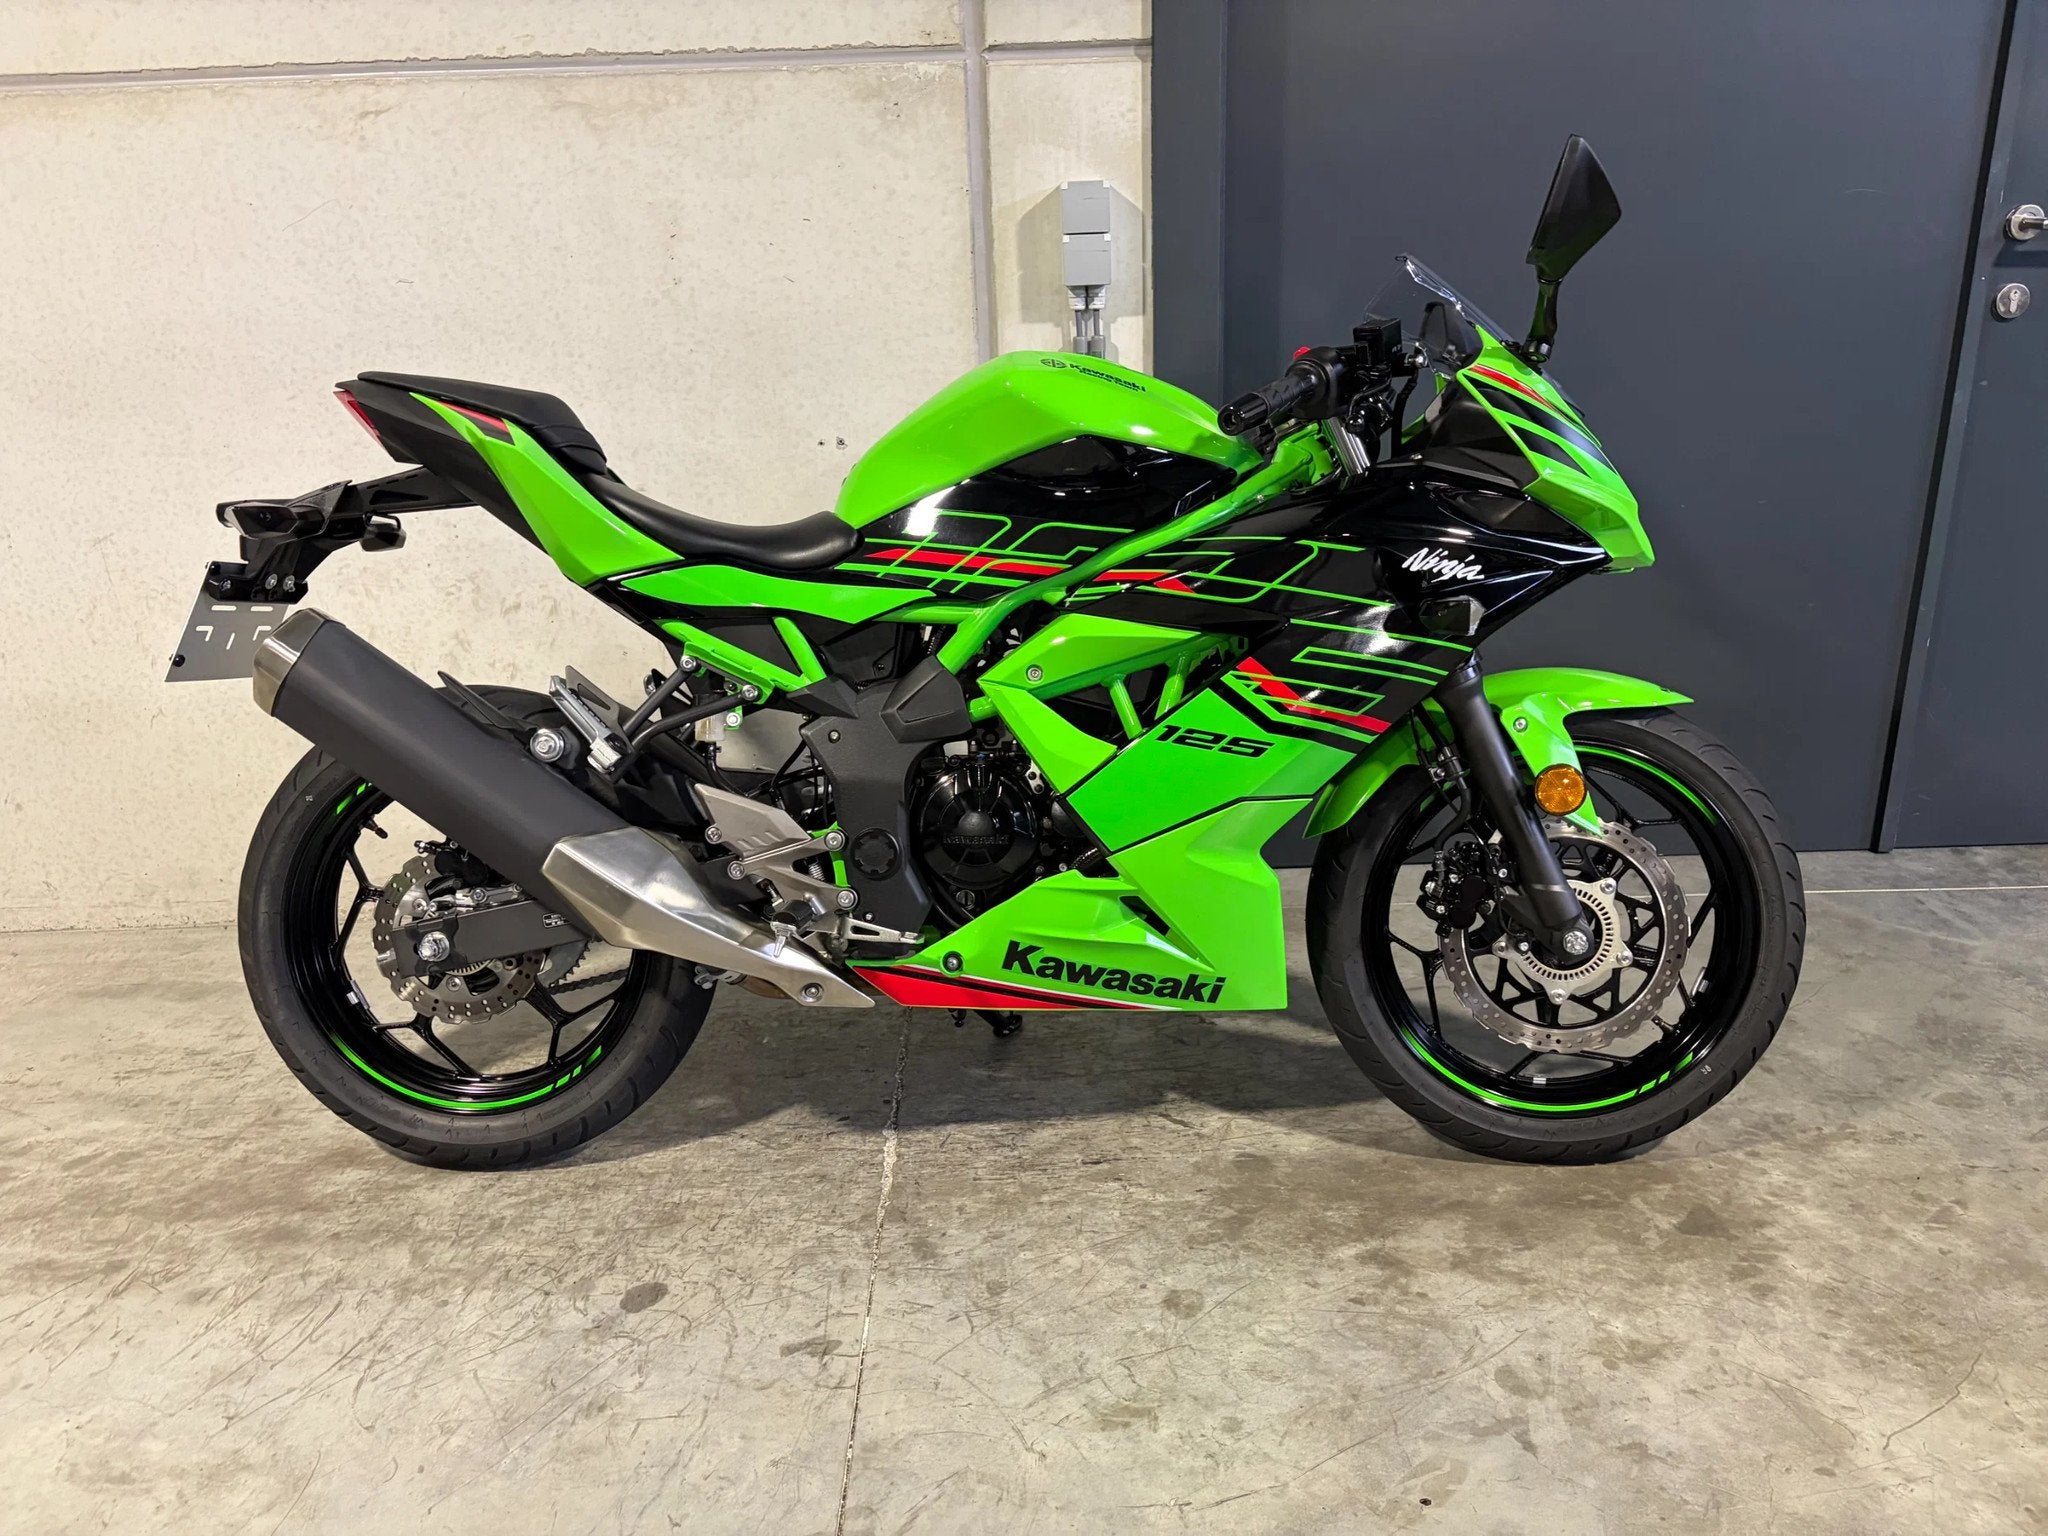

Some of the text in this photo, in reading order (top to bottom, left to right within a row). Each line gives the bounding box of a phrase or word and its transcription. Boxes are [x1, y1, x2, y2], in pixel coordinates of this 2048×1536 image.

[1070, 363, 1146, 392] Kawasaki
[1402, 548, 1485, 583] Ninja
[1155, 724, 1276, 758] 125
[1001, 939, 1226, 1004] Kawasaki
